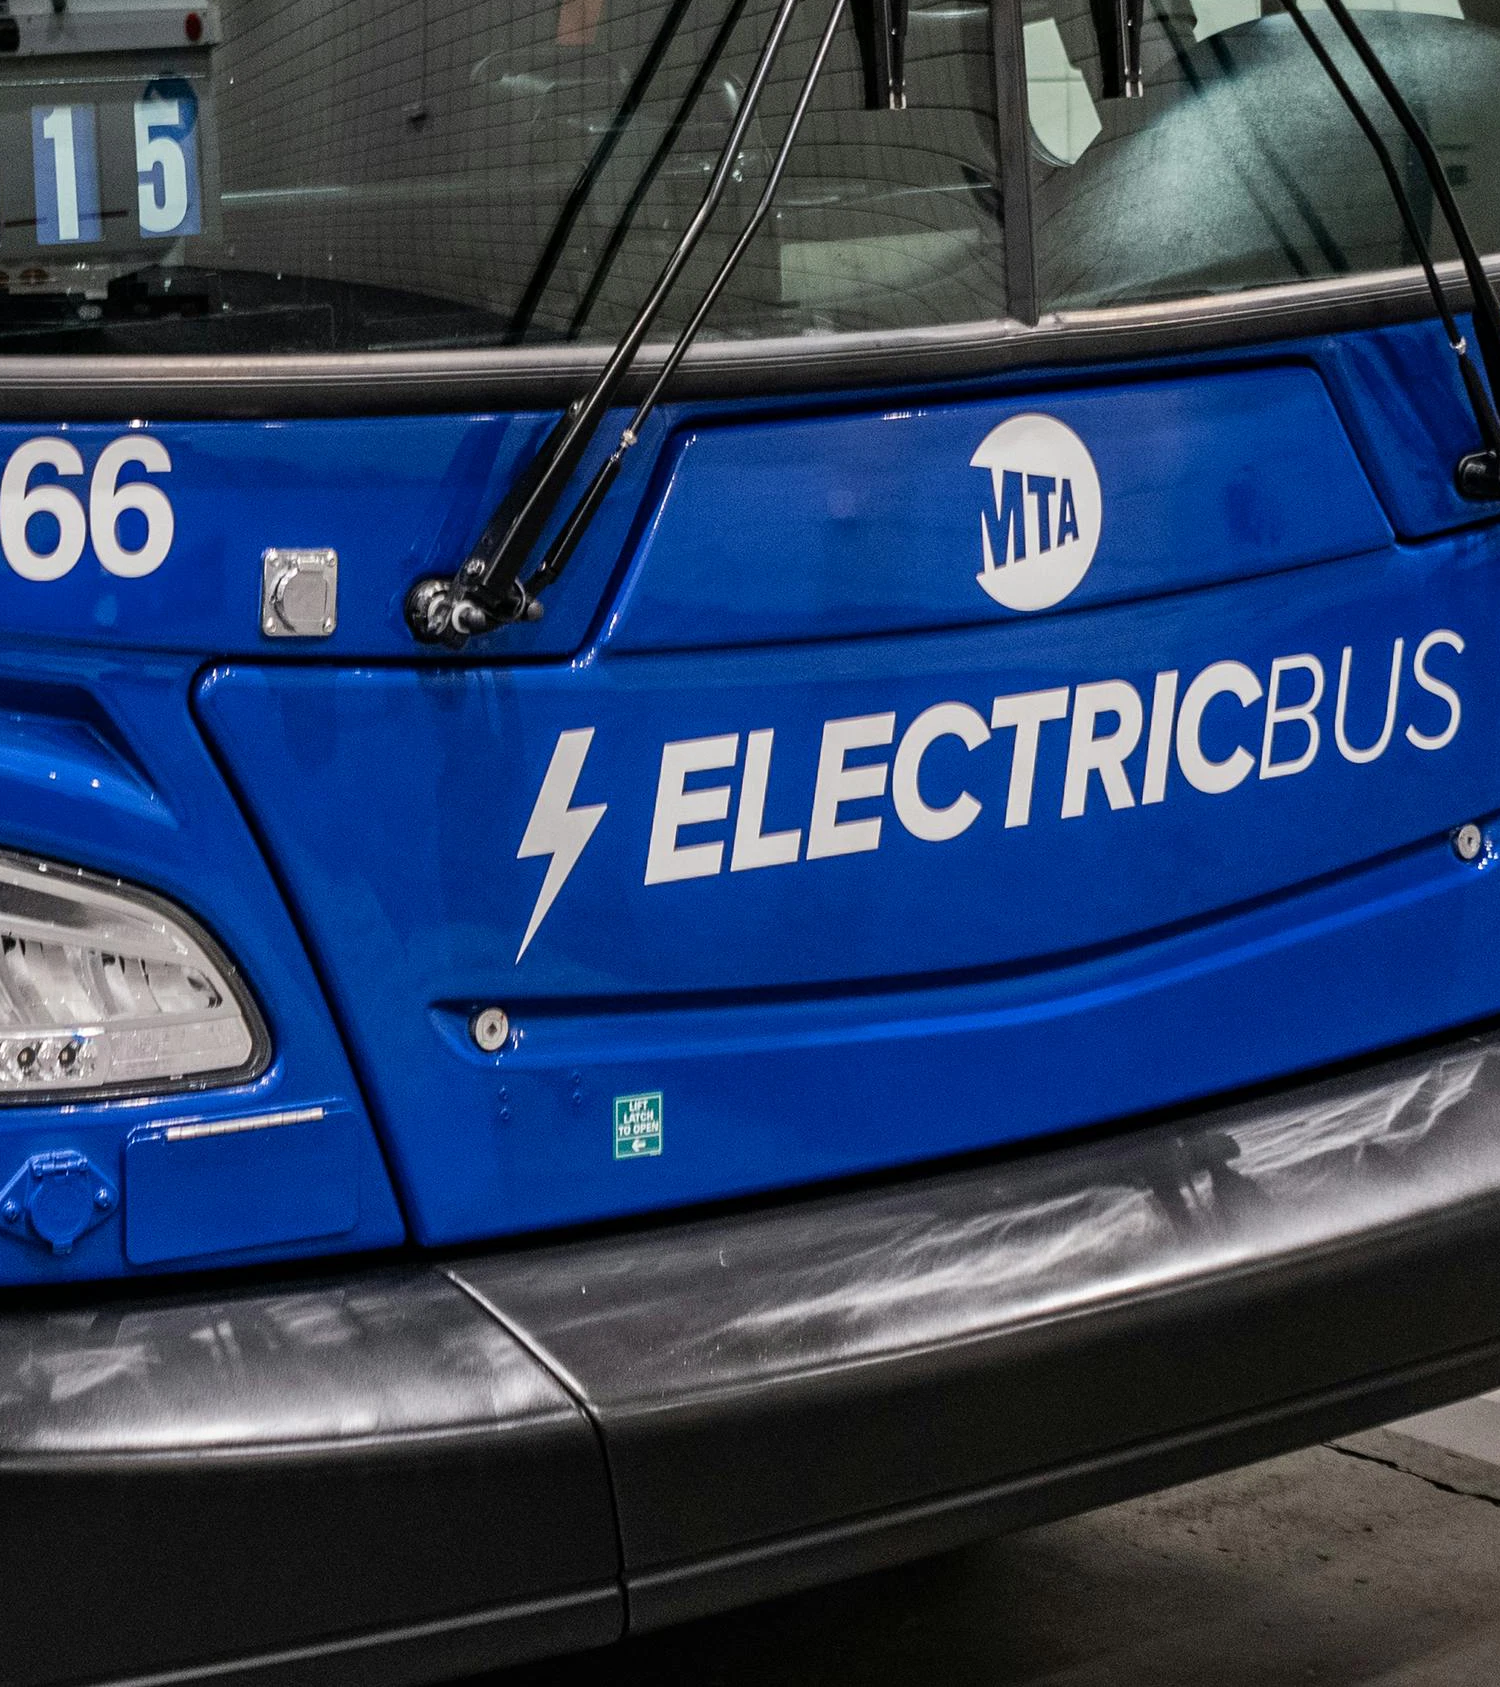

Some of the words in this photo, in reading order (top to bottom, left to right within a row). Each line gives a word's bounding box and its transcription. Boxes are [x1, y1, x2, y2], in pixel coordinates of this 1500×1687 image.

[972, 464, 1080, 575] MTA
[643, 627, 1466, 885] ELECTRICBUS
[629, 1099, 649, 1113] LIFT
[623, 1109, 654, 1124] LATCH
[618, 1123, 631, 1136] TO
[633, 1120, 659, 1135] OPEN
